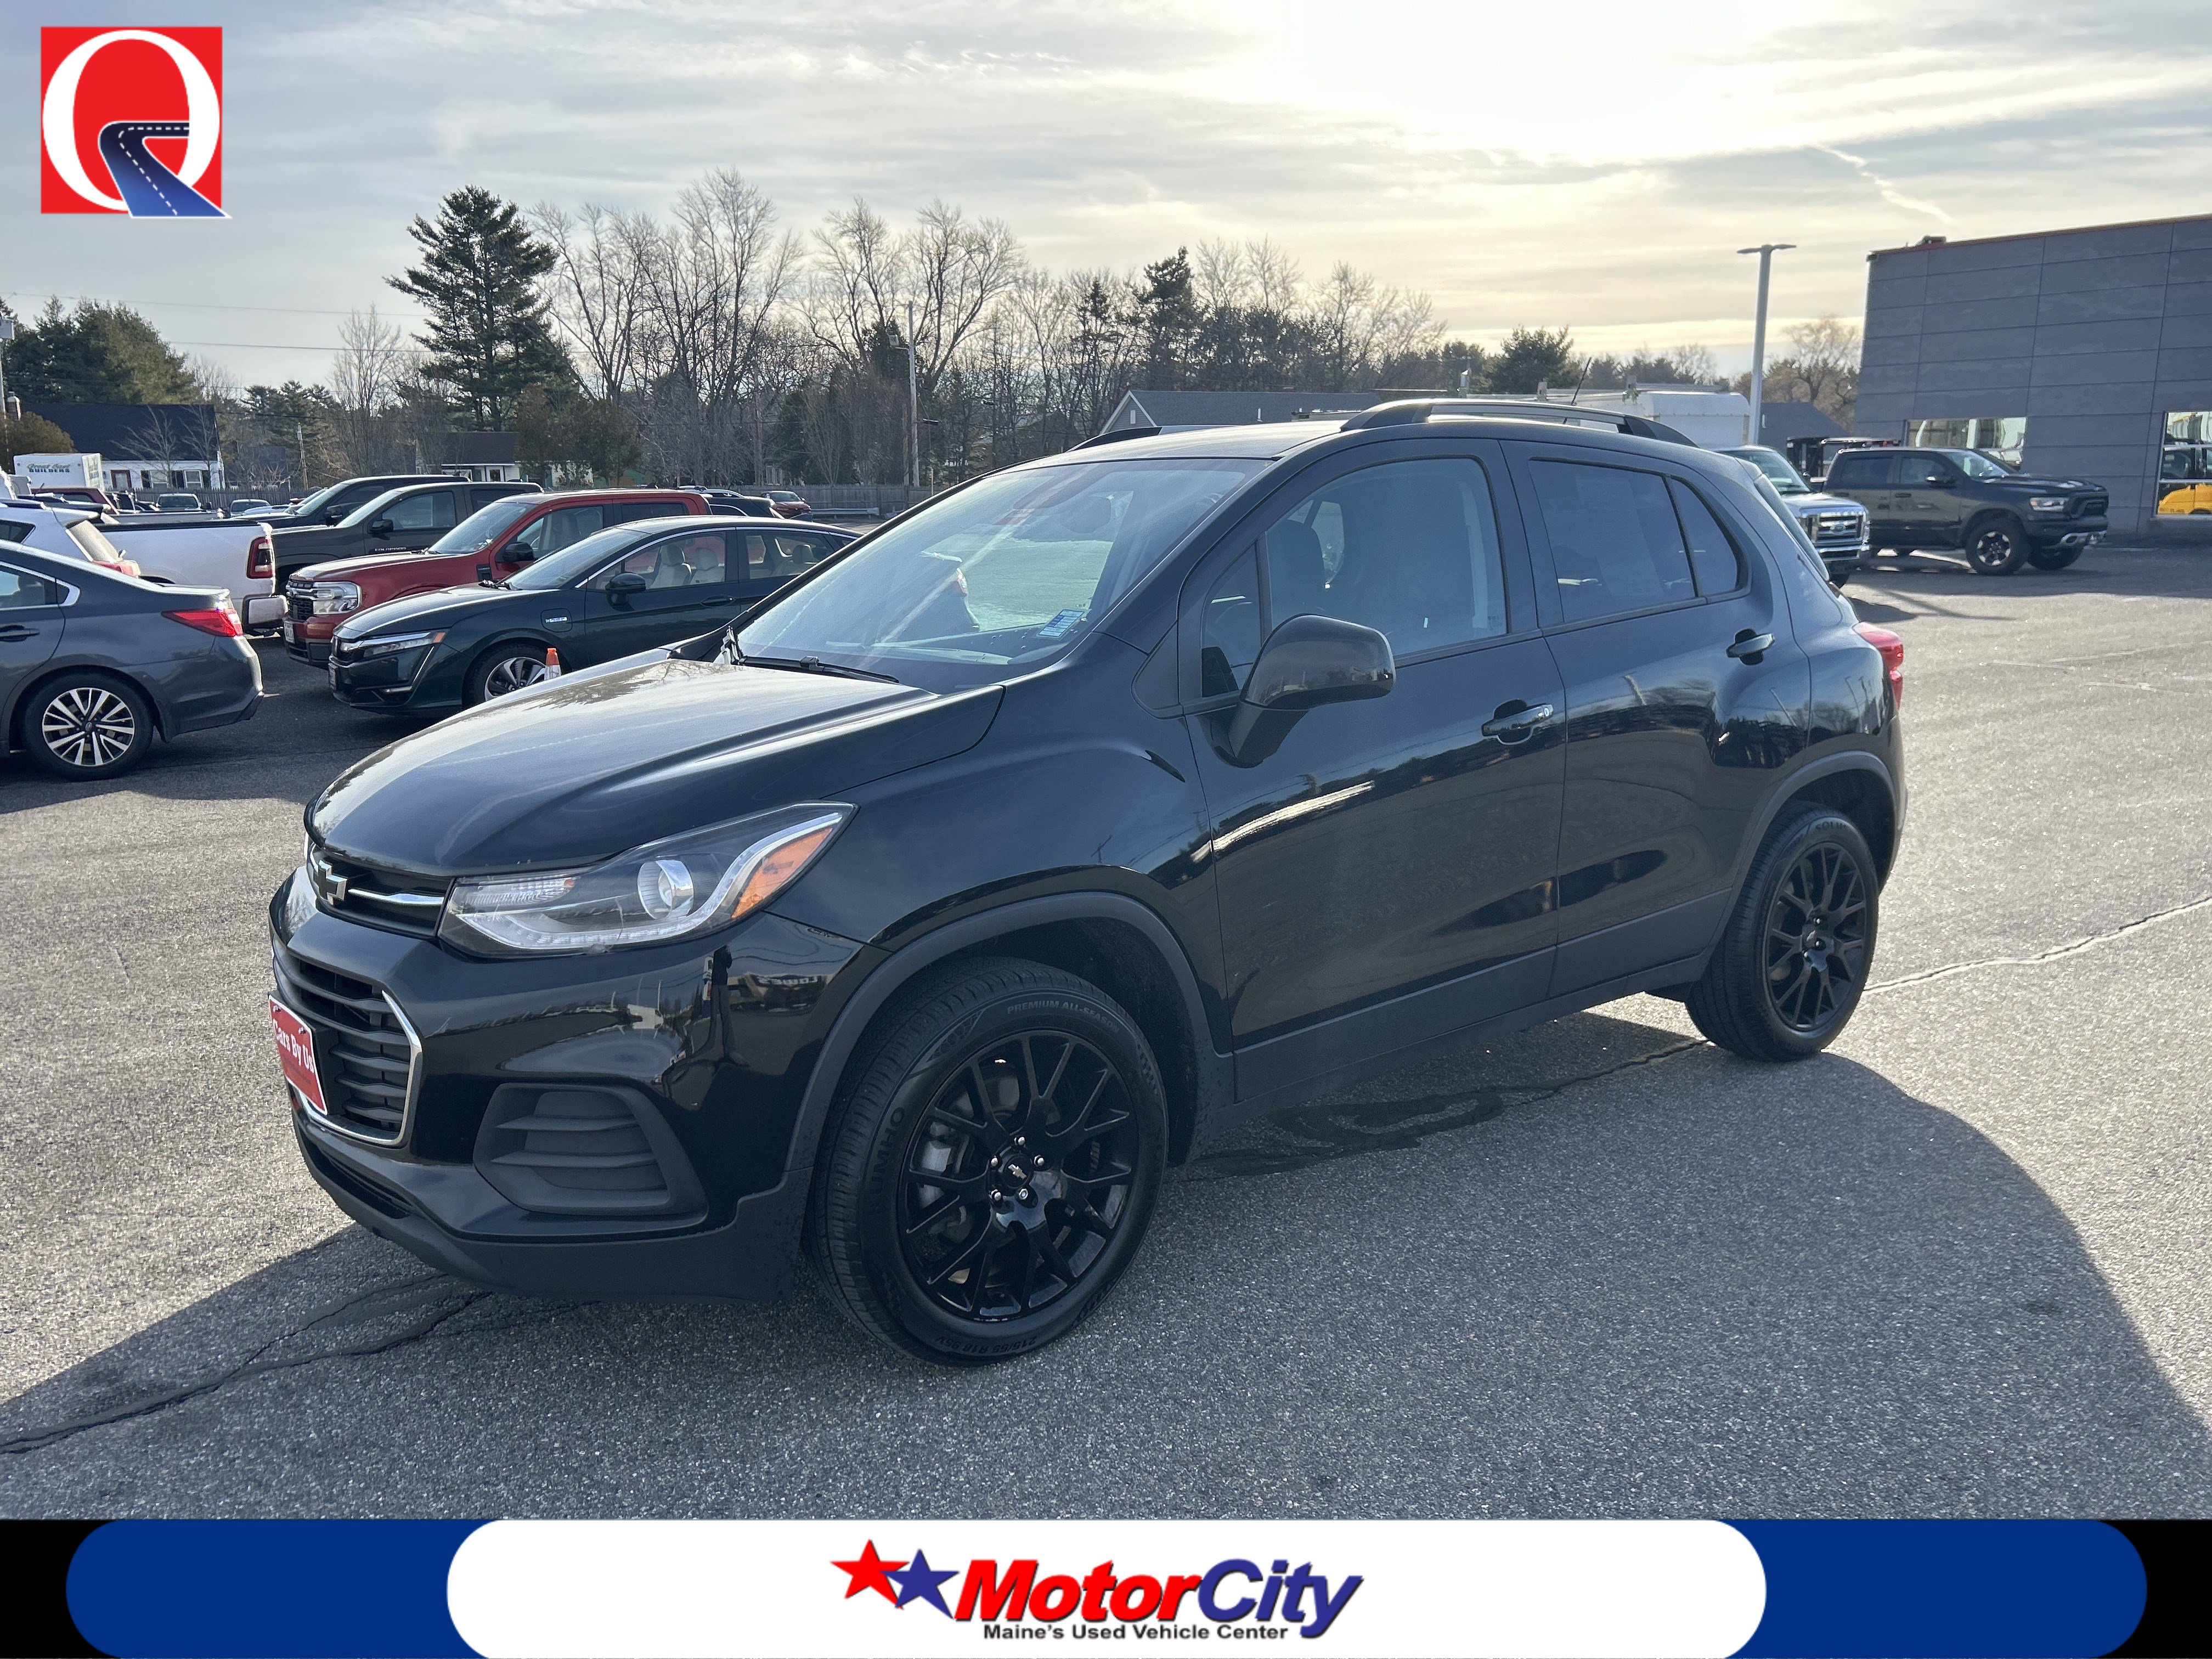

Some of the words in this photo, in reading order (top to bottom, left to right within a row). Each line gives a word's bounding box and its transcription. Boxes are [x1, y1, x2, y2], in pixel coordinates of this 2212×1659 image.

[1007, 1000, 1060, 1014] PREMIUM
[273, 1019, 291, 1052] Cars
[291, 1034, 302, 1066] By
[302, 1044, 315, 1074] Us
